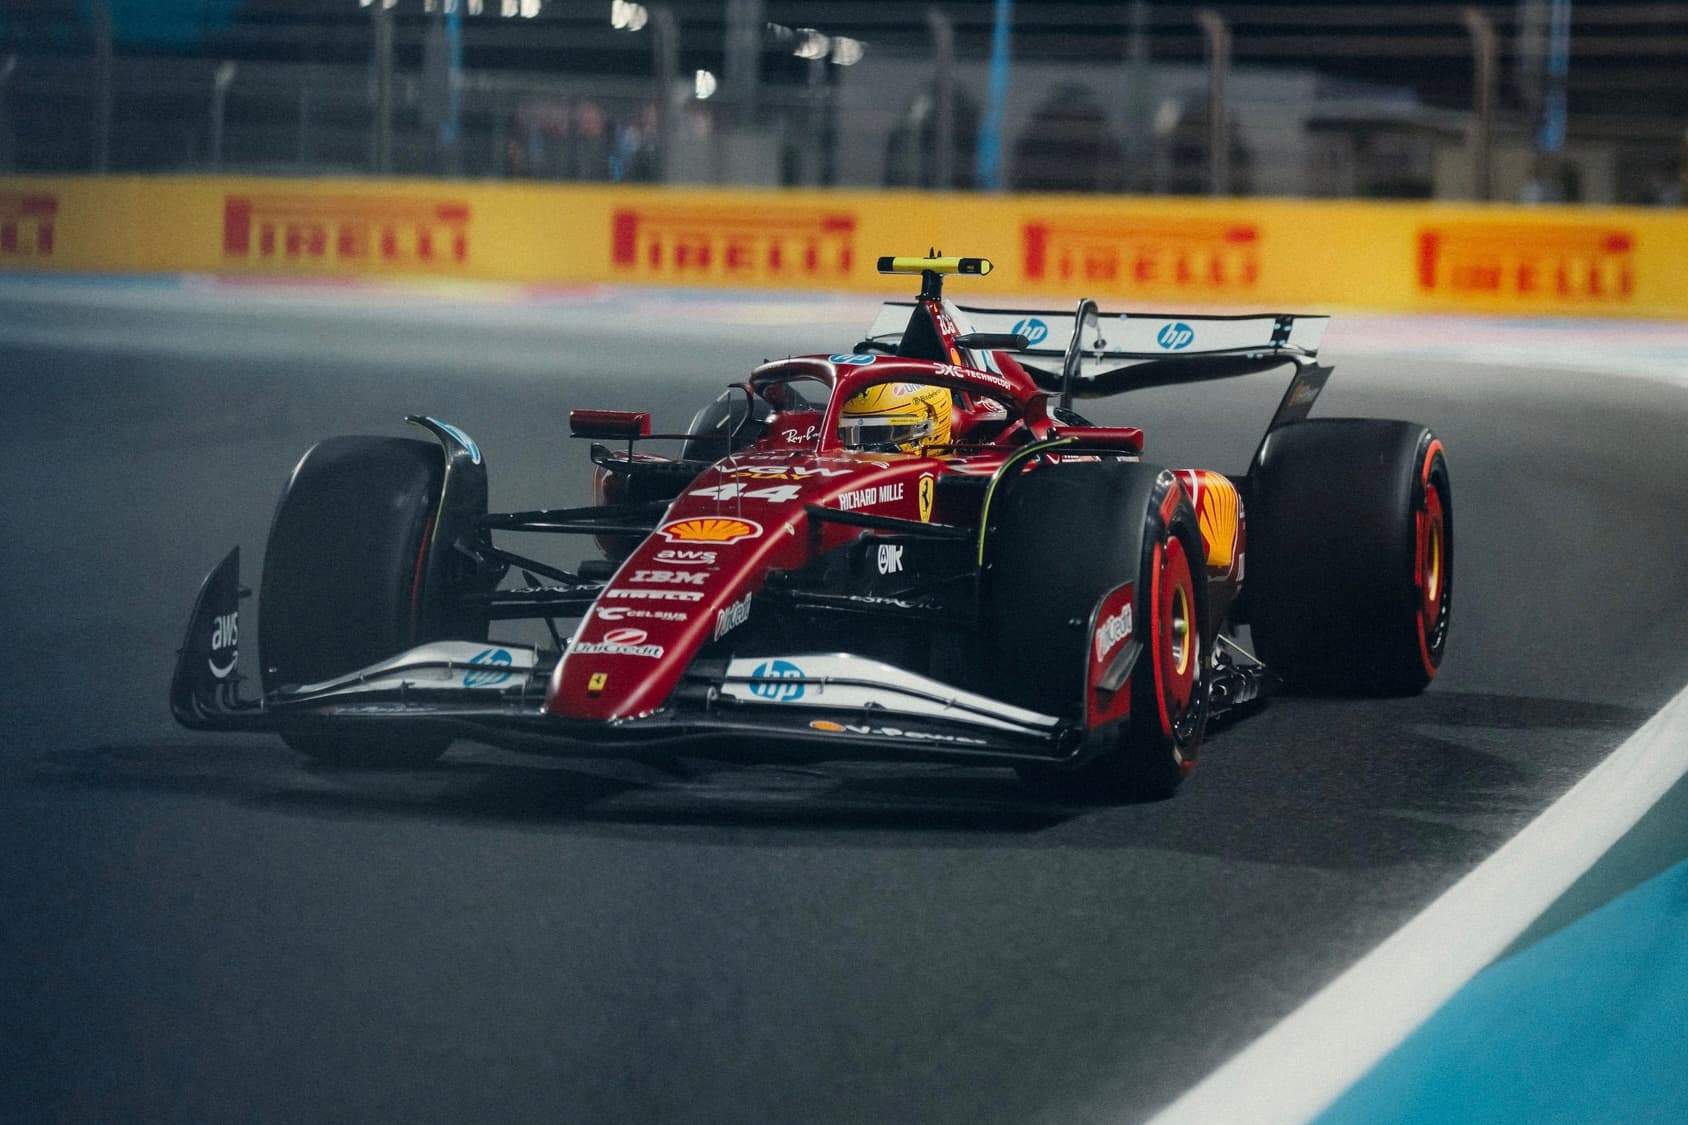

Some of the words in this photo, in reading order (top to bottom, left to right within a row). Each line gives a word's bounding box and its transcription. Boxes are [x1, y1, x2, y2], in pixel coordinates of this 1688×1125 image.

[224, 196, 469, 260] PIRELLI
[611, 208, 857, 272] PIRELLI
[1023, 222, 1258, 286] PIRELLI
[1012, 317, 1047, 348] hp
[1158, 321, 1194, 350] hp
[933, 362, 964, 379] DXC
[965, 369, 1012, 391] TECHNOLOGY
[714, 465, 854, 477] VGW
[688, 482, 803, 503] 44
[838, 487, 877, 511] RICHARD
[879, 482, 904, 503] MILLE
[656, 549, 718, 562] aws
[629, 570, 710, 585] IBM
[606, 588, 705, 602] PIRELLI
[626, 610, 688, 621] CELSIUS
[212, 612, 239, 651] aws
[751, 659, 805, 701] hp
